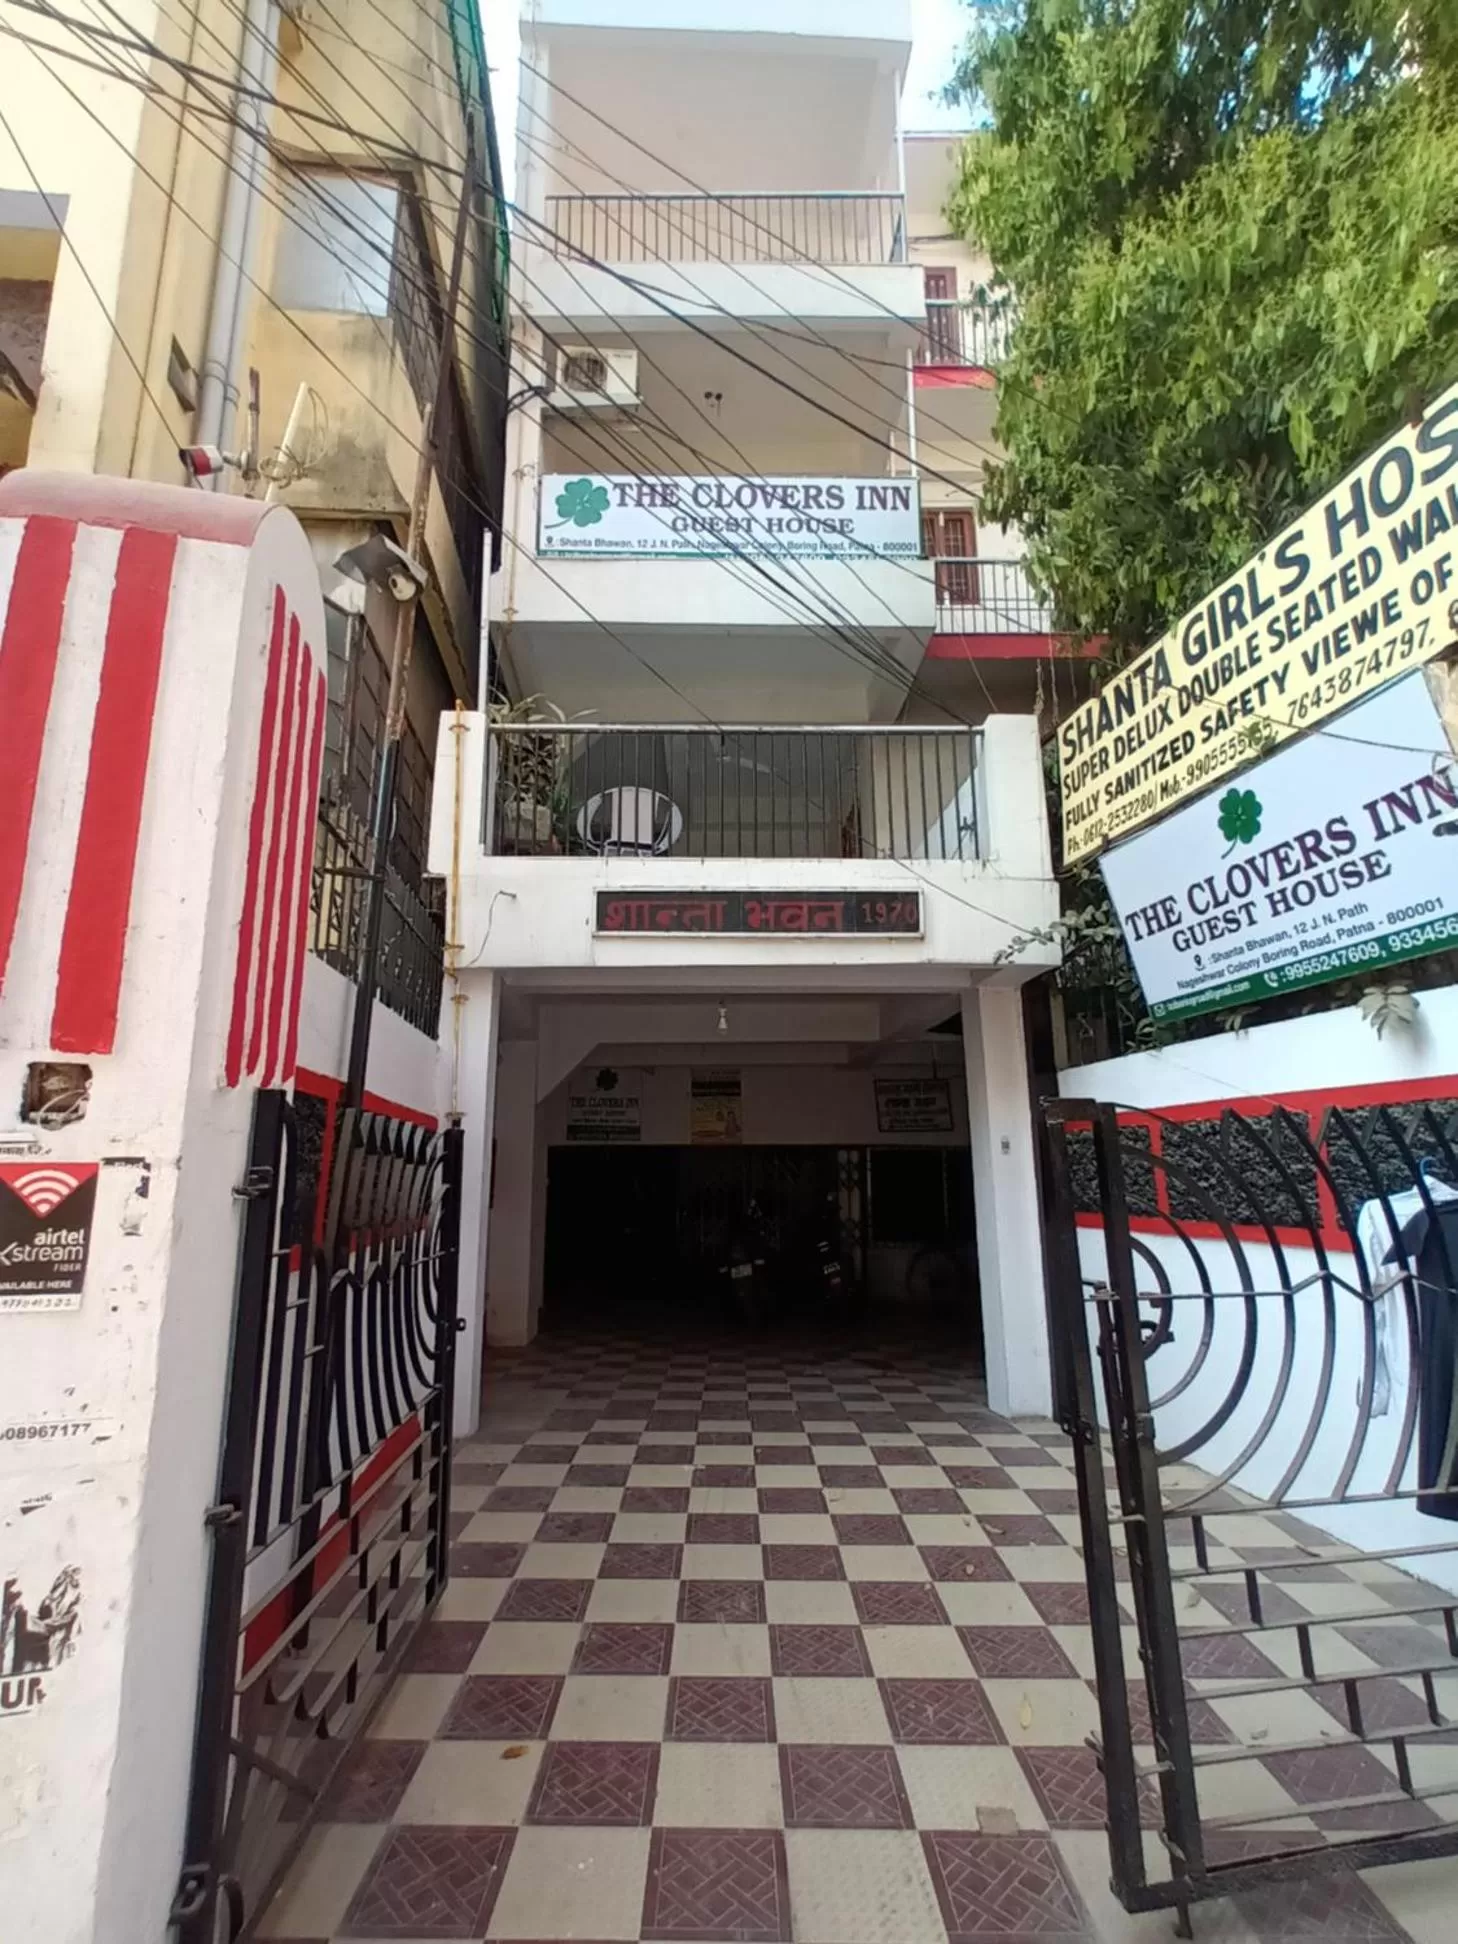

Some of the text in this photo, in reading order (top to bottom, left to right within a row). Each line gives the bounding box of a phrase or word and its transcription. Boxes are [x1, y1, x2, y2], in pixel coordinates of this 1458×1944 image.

[612, 482, 912, 511] THE CLOVERS INN
[671, 515, 856, 536] GUEST HOUSE
[636, 539, 648, 549] 12
[883, 542, 917, 552] 800001
[1062, 646, 1172, 767] SHANTA
[1181, 530, 1311, 667] GIRL'S
[1063, 745, 1110, 800] SUPER
[1113, 696, 1174, 763] DELUX
[1177, 631, 1262, 718] DOUBLE
[1266, 545, 1383, 654] SEATED
[1065, 789, 1101, 832] FULLY
[1104, 730, 1195, 805] SANITIZED
[1200, 660, 1291, 744] SAFETY
[1301, 588, 1403, 677] VIEWE
[1410, 551, 1453, 606] OF
[1125, 764, 1458, 942] THE CLOVERS INN
[604, 899, 727, 931] शान्ता
[743, 899, 845, 930] भवन
[1172, 848, 1393, 953] GUEST HOUSE
[1244, 928, 1293, 951] Bhawan,
[1293, 921, 1310, 937] 12
[1310, 917, 1322, 931] J.
[1321, 912, 1337, 926] N.
[1337, 901, 1370, 921] Path
[1225, 956, 1261, 976] Colony
[1261, 943, 1299, 964] Boring
[1299, 933, 1337, 953] Road,
[1336, 919, 1376, 942] Patna
[1385, 896, 1444, 926] 800001
[33, 1228, 86, 1247] airtel
